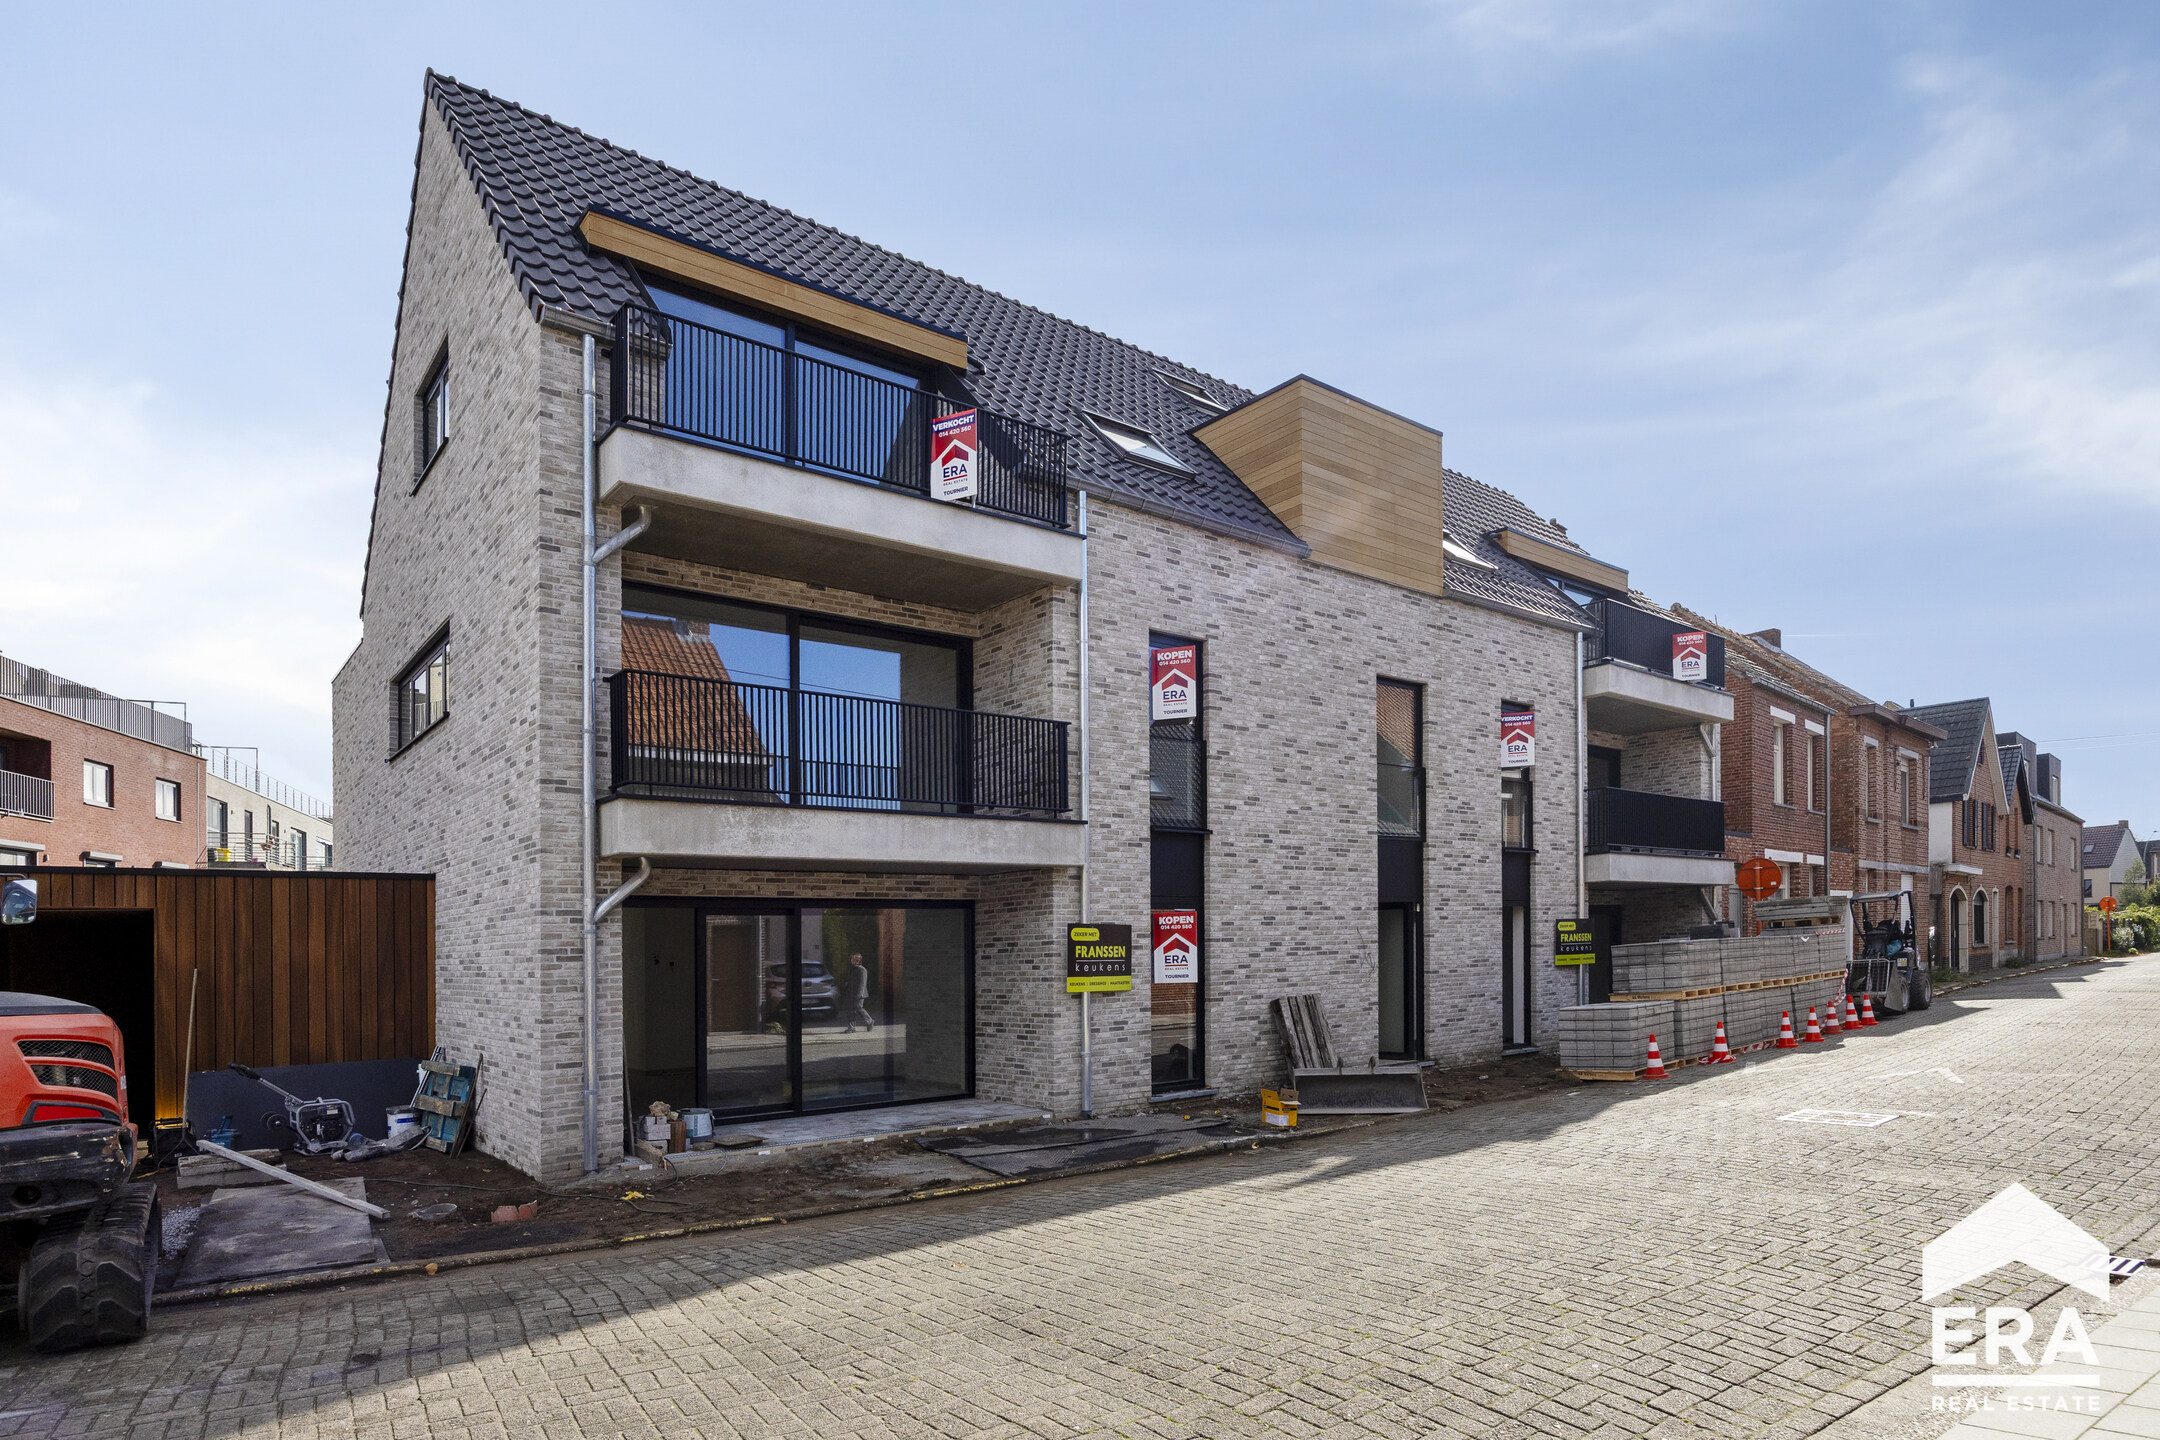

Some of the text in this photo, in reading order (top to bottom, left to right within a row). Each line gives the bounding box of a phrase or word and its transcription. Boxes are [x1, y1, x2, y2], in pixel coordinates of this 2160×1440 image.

[932, 415, 974, 432] VERKOCHT
[943, 464, 967, 478] ERA
[944, 486, 968, 496] TOURNIER
[1677, 634, 1704, 642] KOPEN
[1157, 650, 1192, 661] KOPEN
[1163, 690, 1186, 700] ERA
[1159, 916, 1194, 925] KOPEN
[1560, 933, 1592, 942] FRANSSEN
[1076, 946, 1126, 958] FRANSSEN
[1164, 955, 1188, 964] ERA
[1075, 963, 1126, 972] keukens
